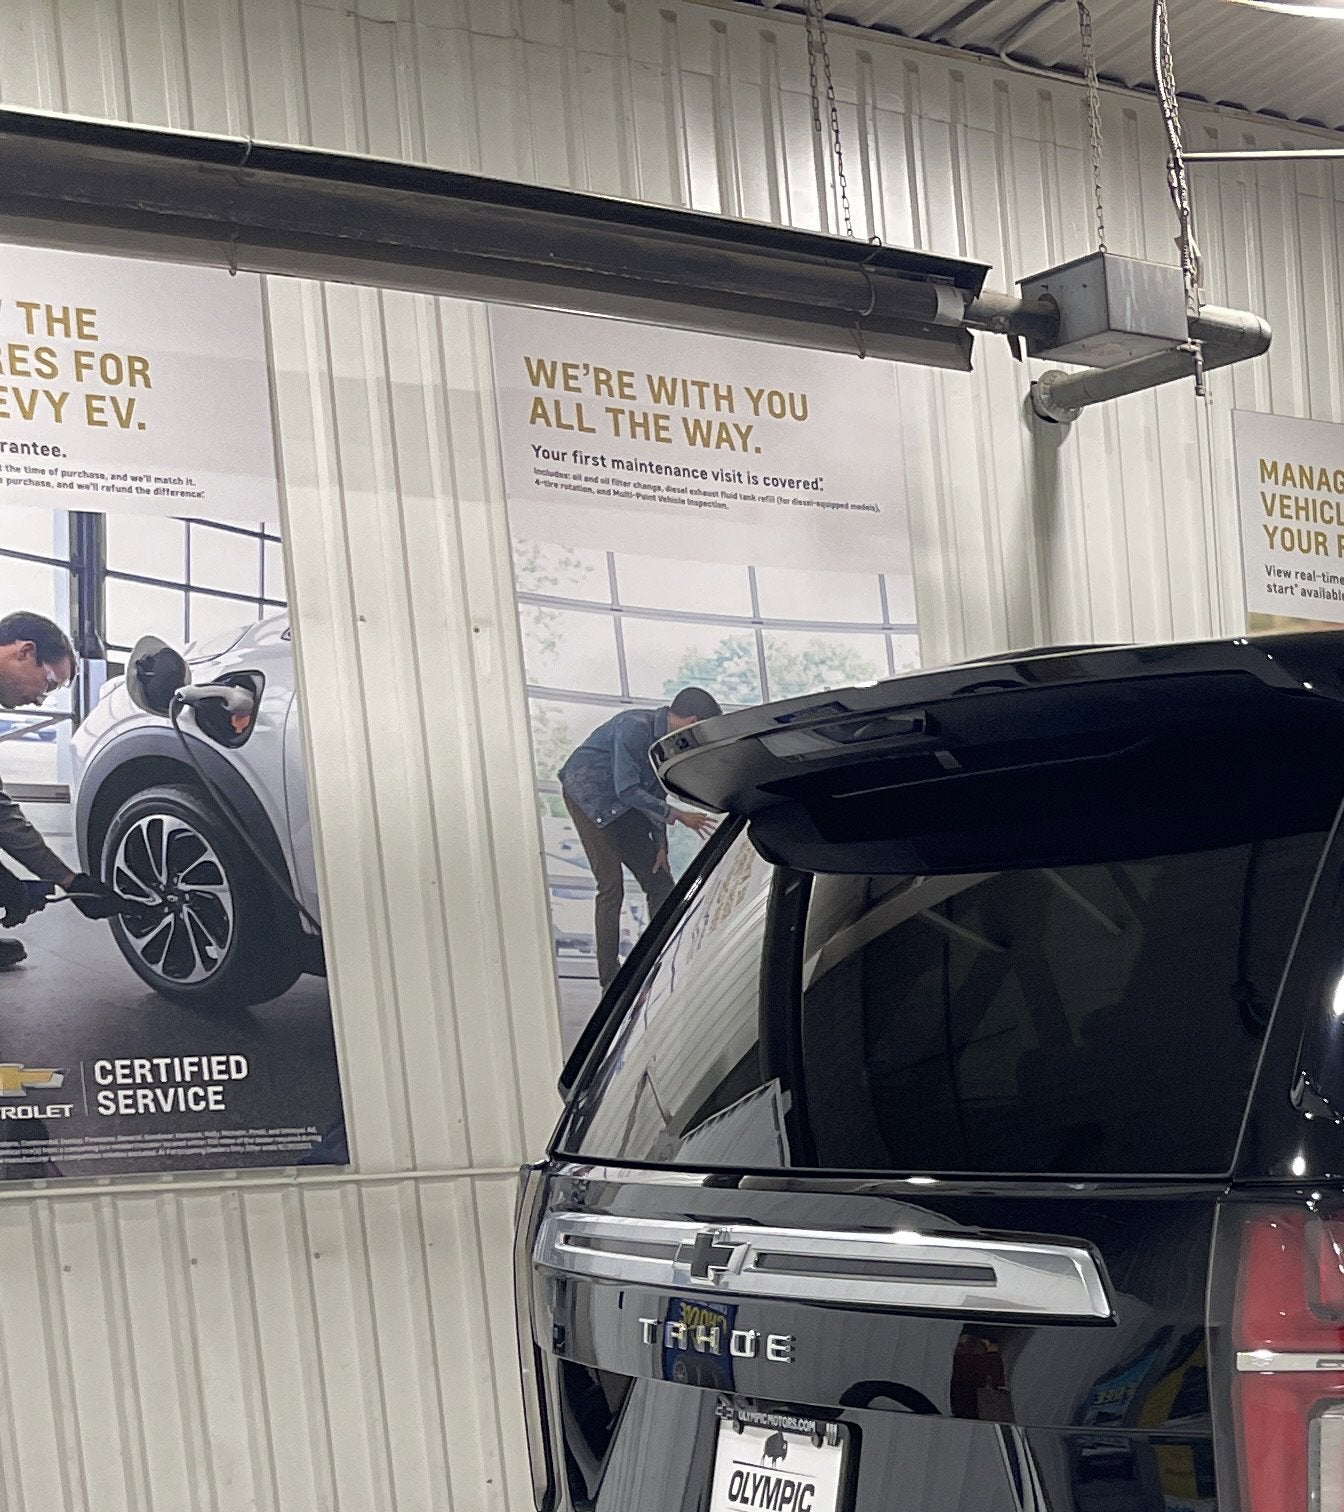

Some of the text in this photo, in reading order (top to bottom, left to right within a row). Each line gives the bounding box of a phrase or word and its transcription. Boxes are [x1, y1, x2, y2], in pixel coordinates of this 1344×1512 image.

[16, 301, 98, 341] THE
[0, 344, 152, 389] ES FOR
[524, 356, 809, 421] WE'RE WITH YOU
[85, 394, 146, 430] EV.
[529, 397, 762, 454] ALL THE WAY.
[5, 464, 21, 473] the
[24, 466, 45, 475] time
[49, 468, 58, 476] of
[532, 444, 567, 462] Your
[572, 450, 607, 468] first
[611, 458, 708, 480] maintenance
[712, 468, 743, 484] visit
[747, 471, 759, 486] is
[135, 486, 151, 495] the
[584, 476, 598, 484] and
[665, 484, 688, 494] diesel
[689, 487, 719, 498] exhaust
[1262, 524, 1329, 556] YOUR
[1265, 564, 1291, 578] View
[94, 1055, 248, 1085] CERTIFIED
[97, 1086, 226, 1116] SERVICE
[638, 1317, 793, 1363] TAHOE
